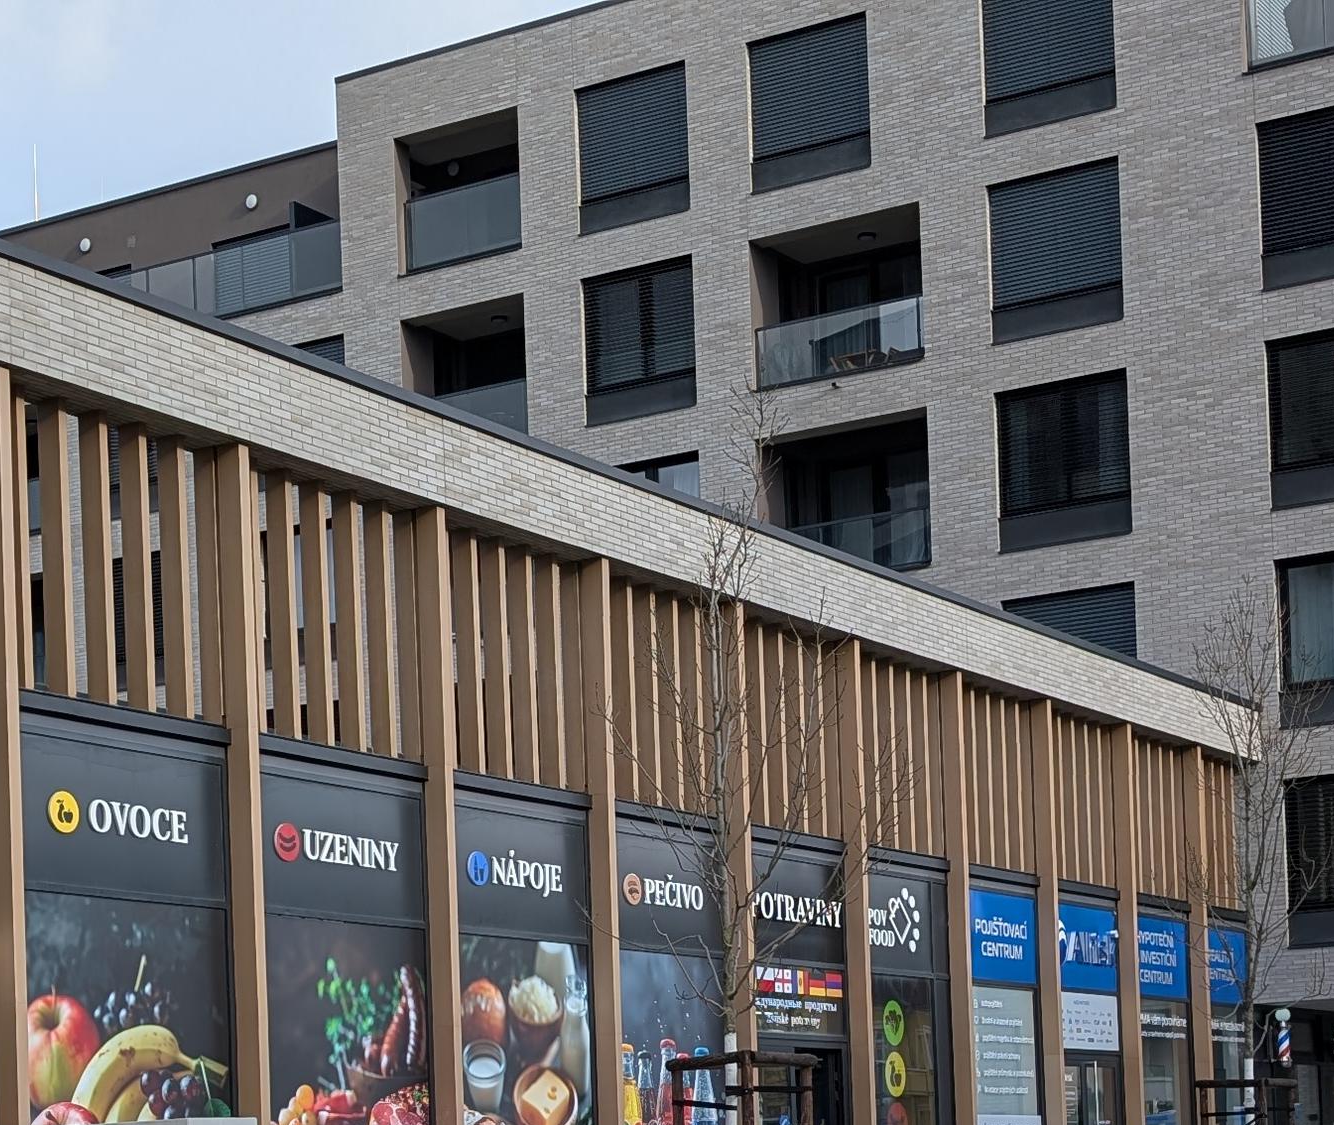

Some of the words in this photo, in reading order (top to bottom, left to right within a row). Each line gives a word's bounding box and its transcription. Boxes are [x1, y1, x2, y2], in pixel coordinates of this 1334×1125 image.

[87, 798, 189, 844] OVOCE
[301, 828, 399, 872] UZENINY
[491, 850, 563, 897] NÁPOJE
[643, 874, 704, 911] PEČIVO
[751, 891, 843, 928] POTRAVINY
[868, 908, 887, 926] POV
[868, 928, 895, 947] FOOD
[975, 916, 1028, 940] POJIŠŤOVACÍ
[981, 941, 1023, 960] CENTRUM
[1139, 969, 1173, 984] CENTRUM
